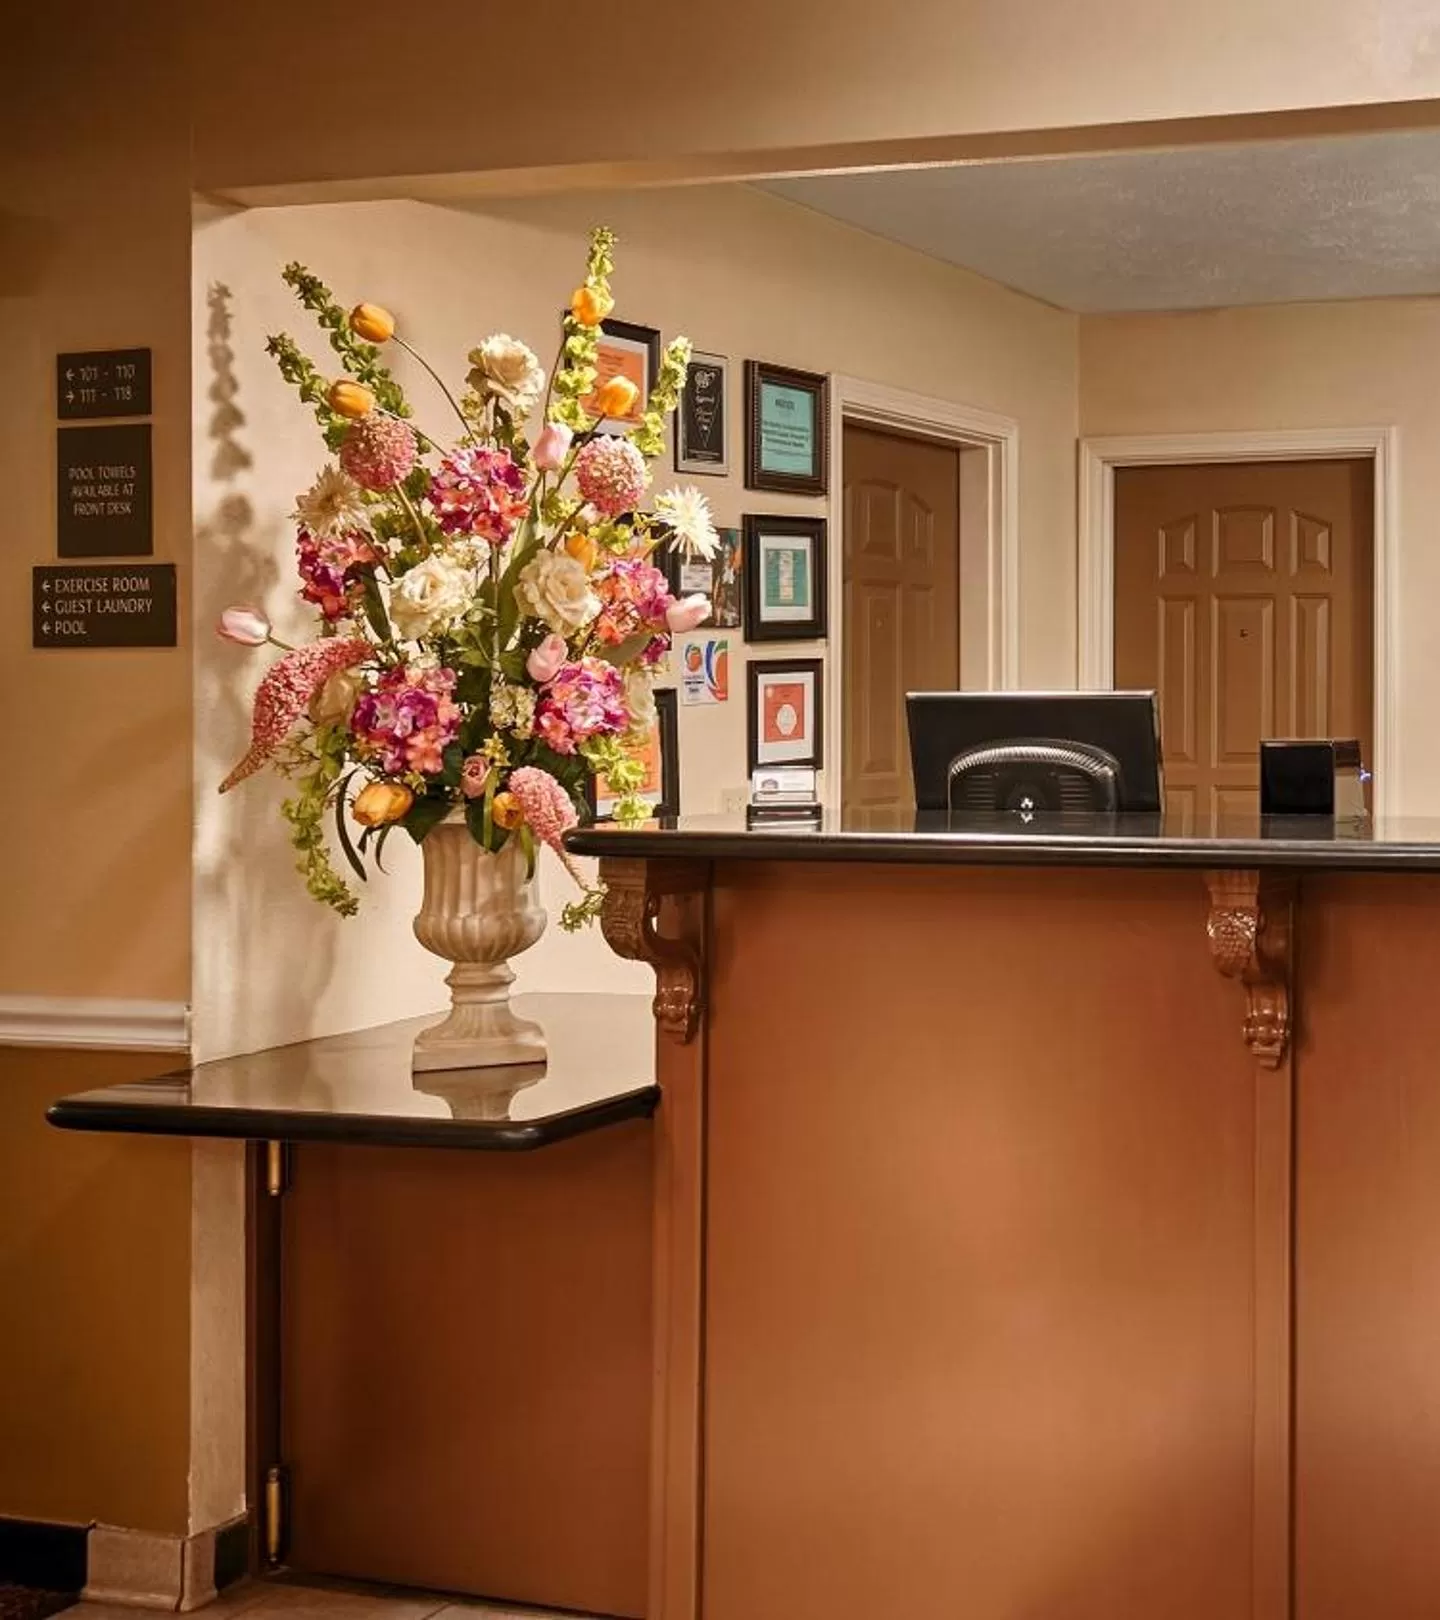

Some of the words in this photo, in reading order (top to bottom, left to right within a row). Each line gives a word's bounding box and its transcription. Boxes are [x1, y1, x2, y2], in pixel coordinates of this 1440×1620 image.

[80, 366, 98, 381] 101
[115, 364, 136, 379] 110
[80, 388, 97, 403] 111
[113, 385, 132, 400] 118
[68, 467, 95, 480] POOL
[98, 465, 136, 479] TOWELS
[72, 484, 120, 497] AVAILABLE
[122, 483, 135, 496] AT
[74, 502, 105, 516] FRONT
[107, 502, 132, 515] DESK
[55, 577, 108, 593] EXERCISE
[112, 577, 150, 592] ROOM
[55, 599, 92, 614] GUEST
[96, 598, 152, 613] LAUNDRY
[55, 620, 87, 634] POOL
